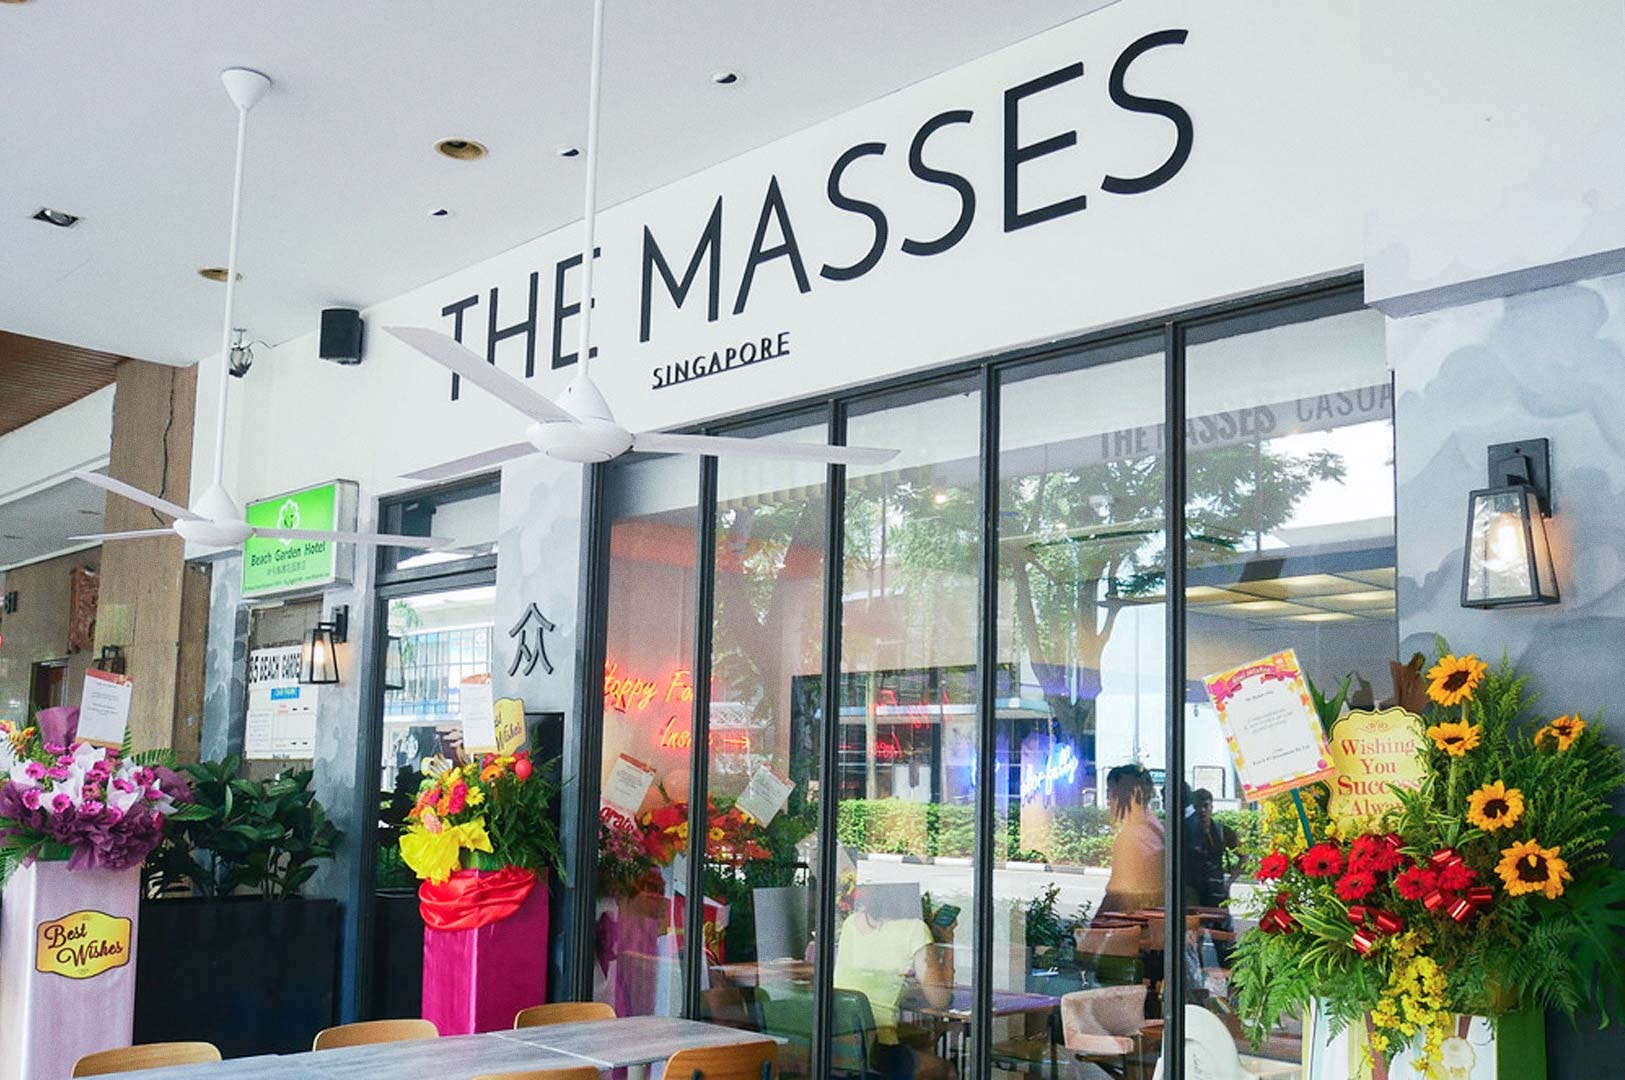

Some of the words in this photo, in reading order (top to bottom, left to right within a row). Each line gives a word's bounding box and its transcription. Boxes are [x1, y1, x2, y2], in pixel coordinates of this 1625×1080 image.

[441, 246, 602, 402] THE
[639, 28, 1195, 344] MASSES
[652, 331, 791, 390] SINGAPORE
[1157, 404, 1277, 447] ASSES
[1296, 383, 1392, 422] CASUA
[251, 552, 273, 567] Beach
[274, 546, 302, 562] Garden
[304, 540, 326, 556] Hotel
[281, 652, 301, 679] GARDE
[1341, 736, 1416, 756] Wishing
[1360, 758, 1396, 775] You
[1337, 774, 1421, 796] Succss
[44, 922, 87, 950] Best
[56, 939, 123, 967] Wishes
